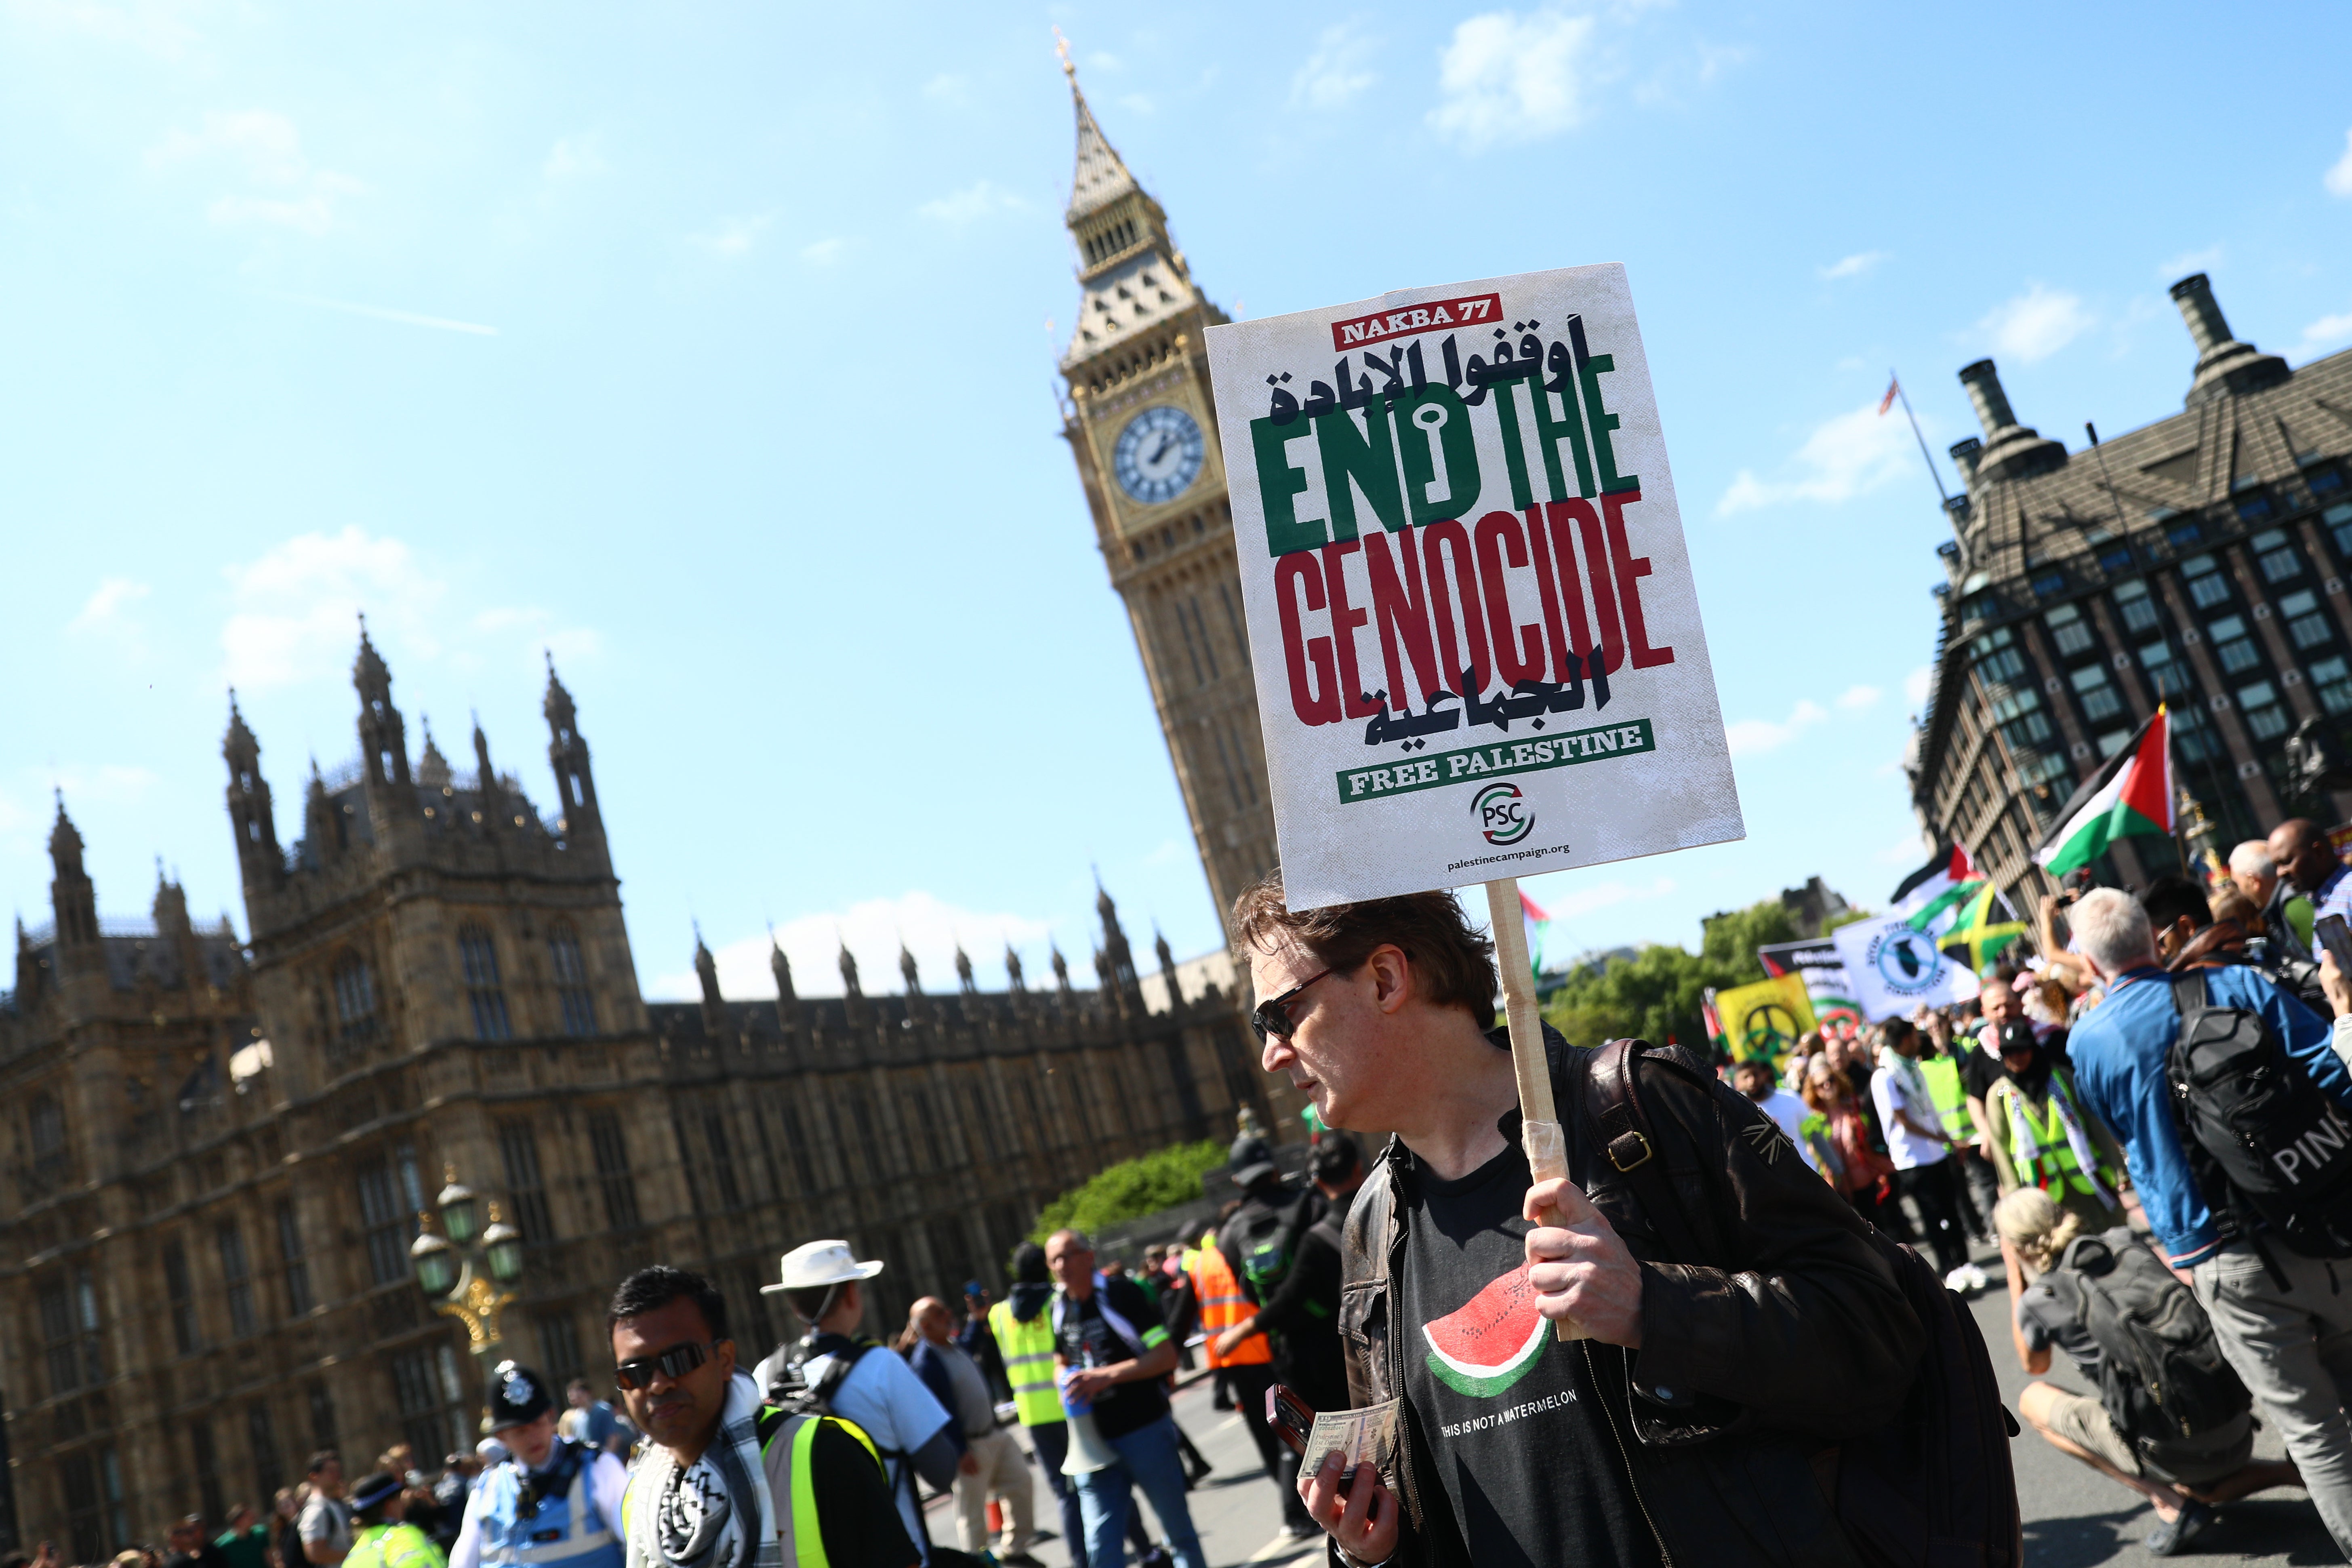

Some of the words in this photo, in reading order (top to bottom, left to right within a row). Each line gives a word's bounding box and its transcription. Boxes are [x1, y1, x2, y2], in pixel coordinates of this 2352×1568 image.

[1341, 306, 1454, 345] NAKBA
[1458, 299, 1492, 321] 77
[1250, 381, 1481, 558] END
[1485, 354, 1640, 512] THE
[1274, 489, 1675, 727] GENOCIDE
[1360, 643, 1611, 753] الجماعية
[1348, 759, 1439, 796] FREE
[1447, 725, 1643, 778] PALESTINE
[1482, 802, 1525, 828] PSC
[1447, 844, 1570, 873] palestinecampaign.org
[1441, 1423, 1460, 1438] THIS
[1463, 1421, 1471, 1433] IS
[1473, 1415, 1495, 1431] NOT
[1498, 1413, 1504, 1426] A
[1503, 1389, 1577, 1423] WATERMELON
